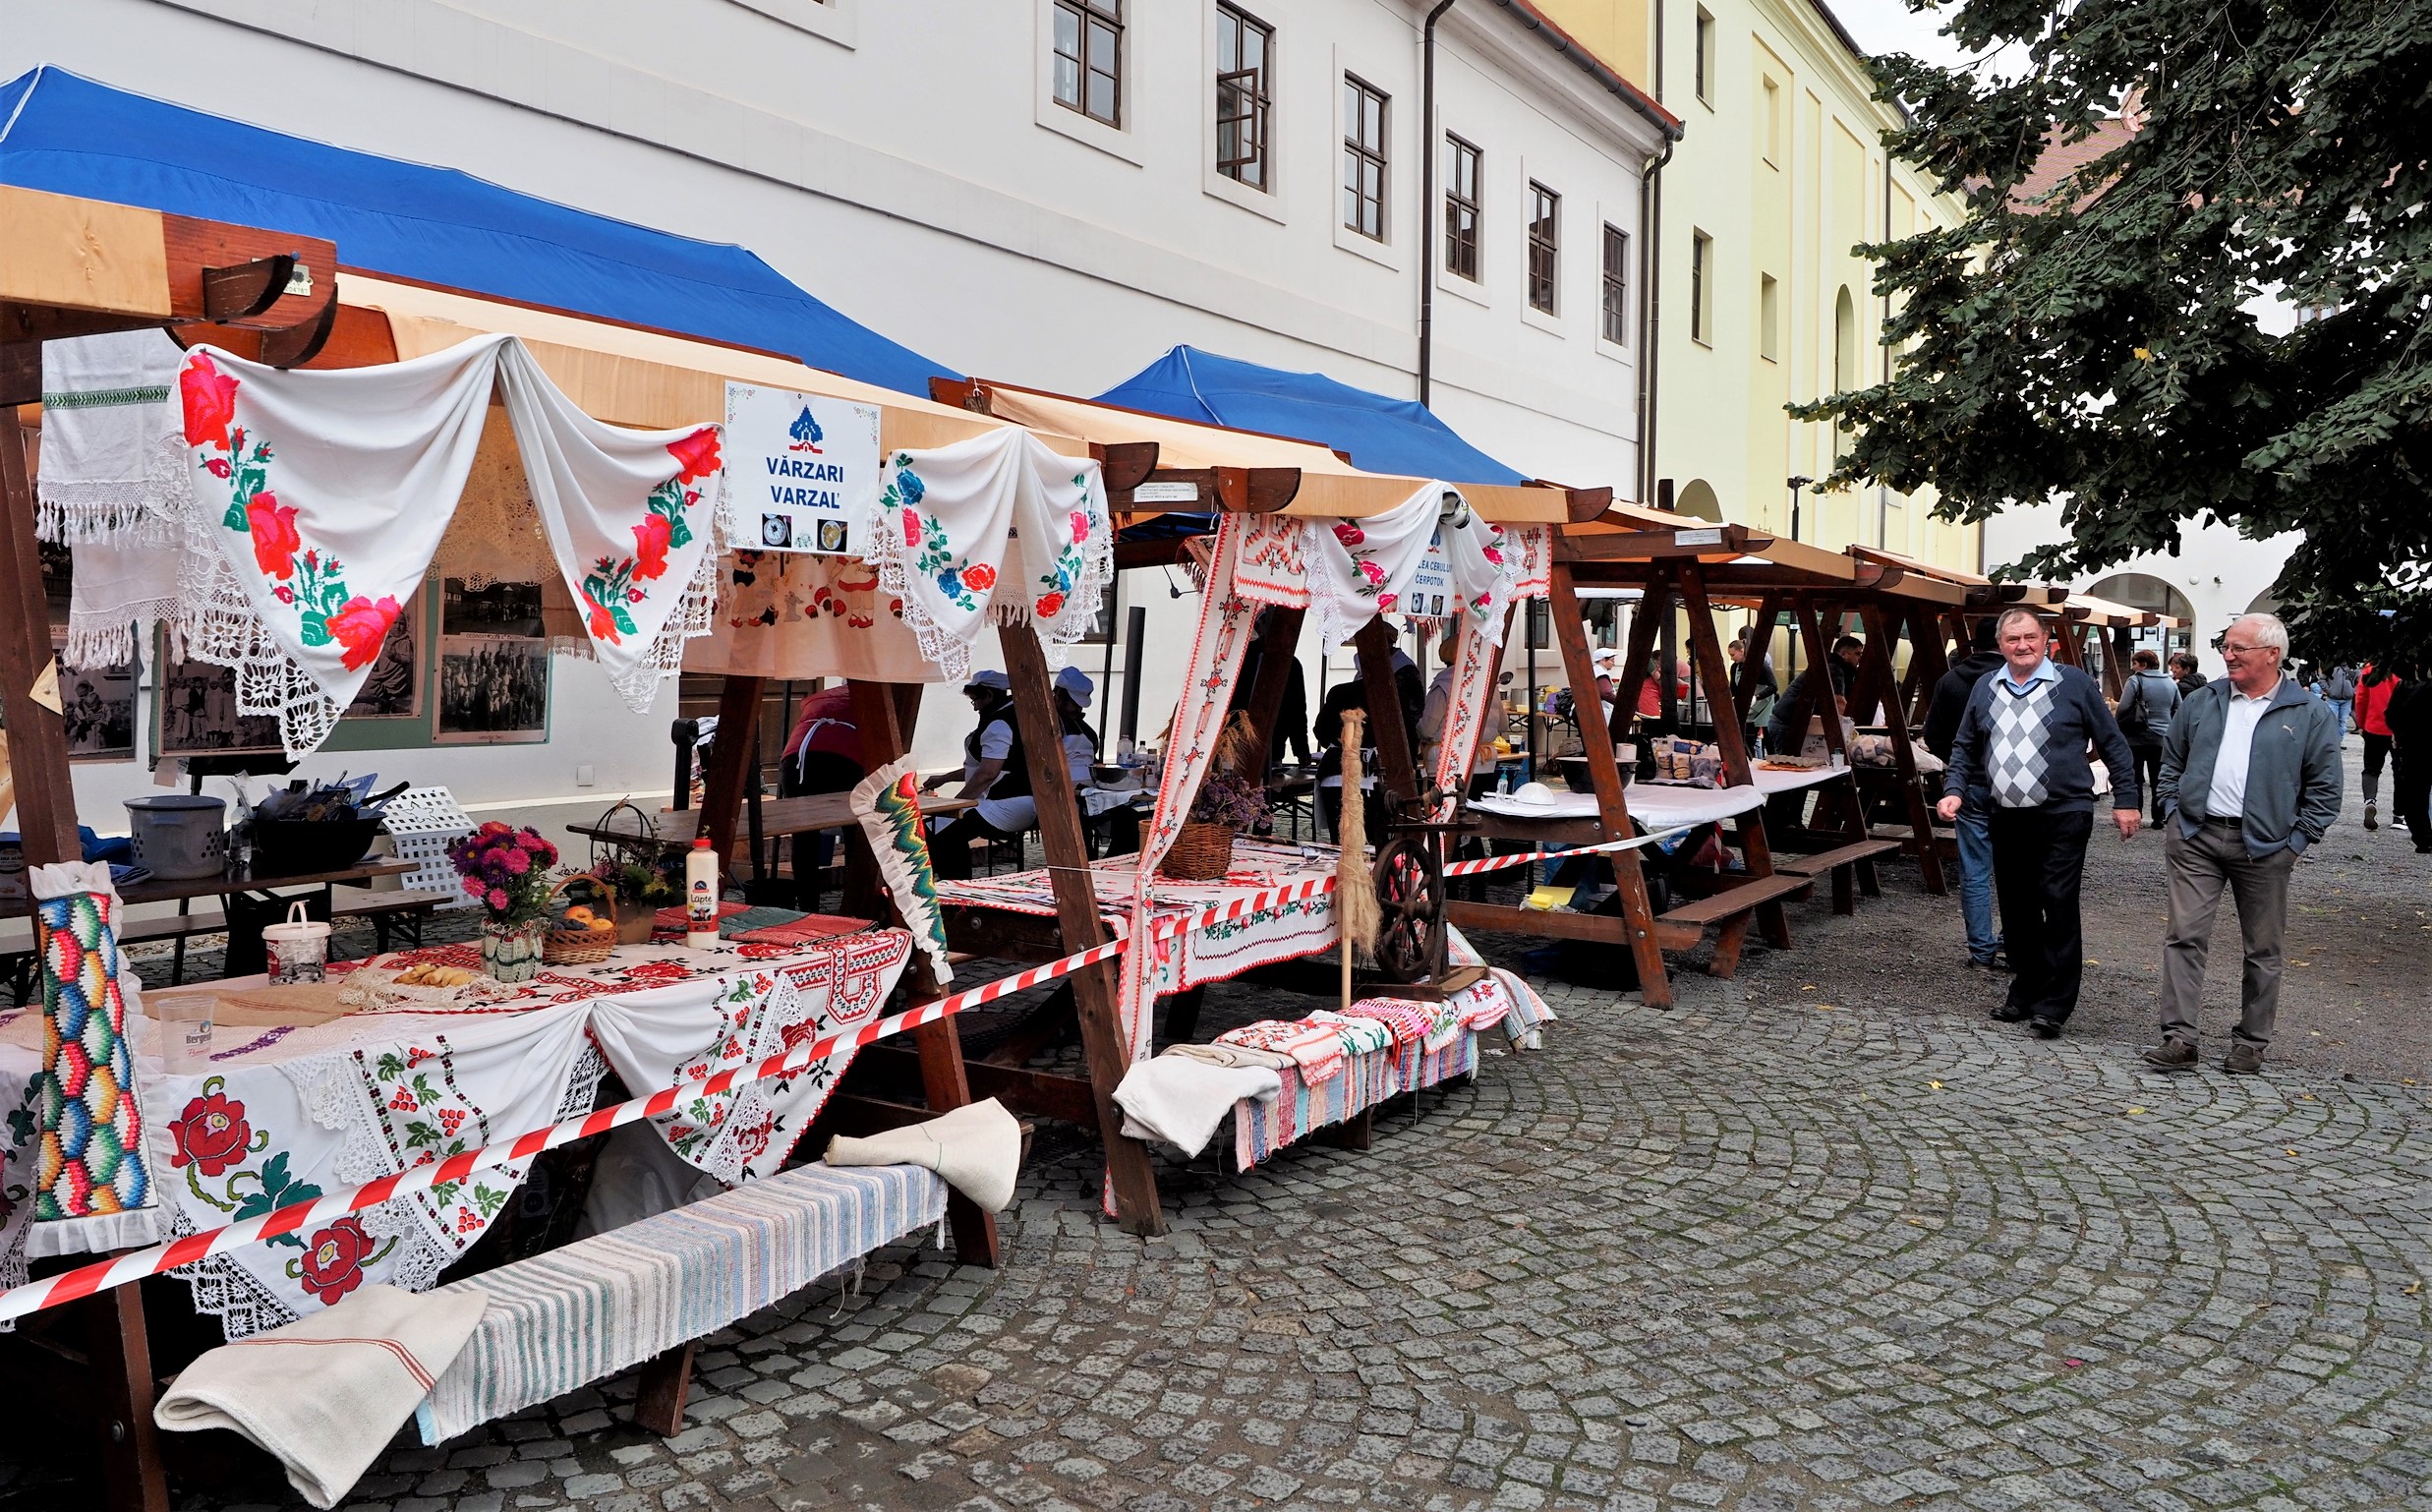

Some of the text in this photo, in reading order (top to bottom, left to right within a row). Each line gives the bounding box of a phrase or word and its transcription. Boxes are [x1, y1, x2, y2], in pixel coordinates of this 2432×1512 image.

[766, 454, 843, 483] VĂRZARI
[770, 485, 840, 509] VARZAĽ
[690, 894, 713, 905] Lapte
